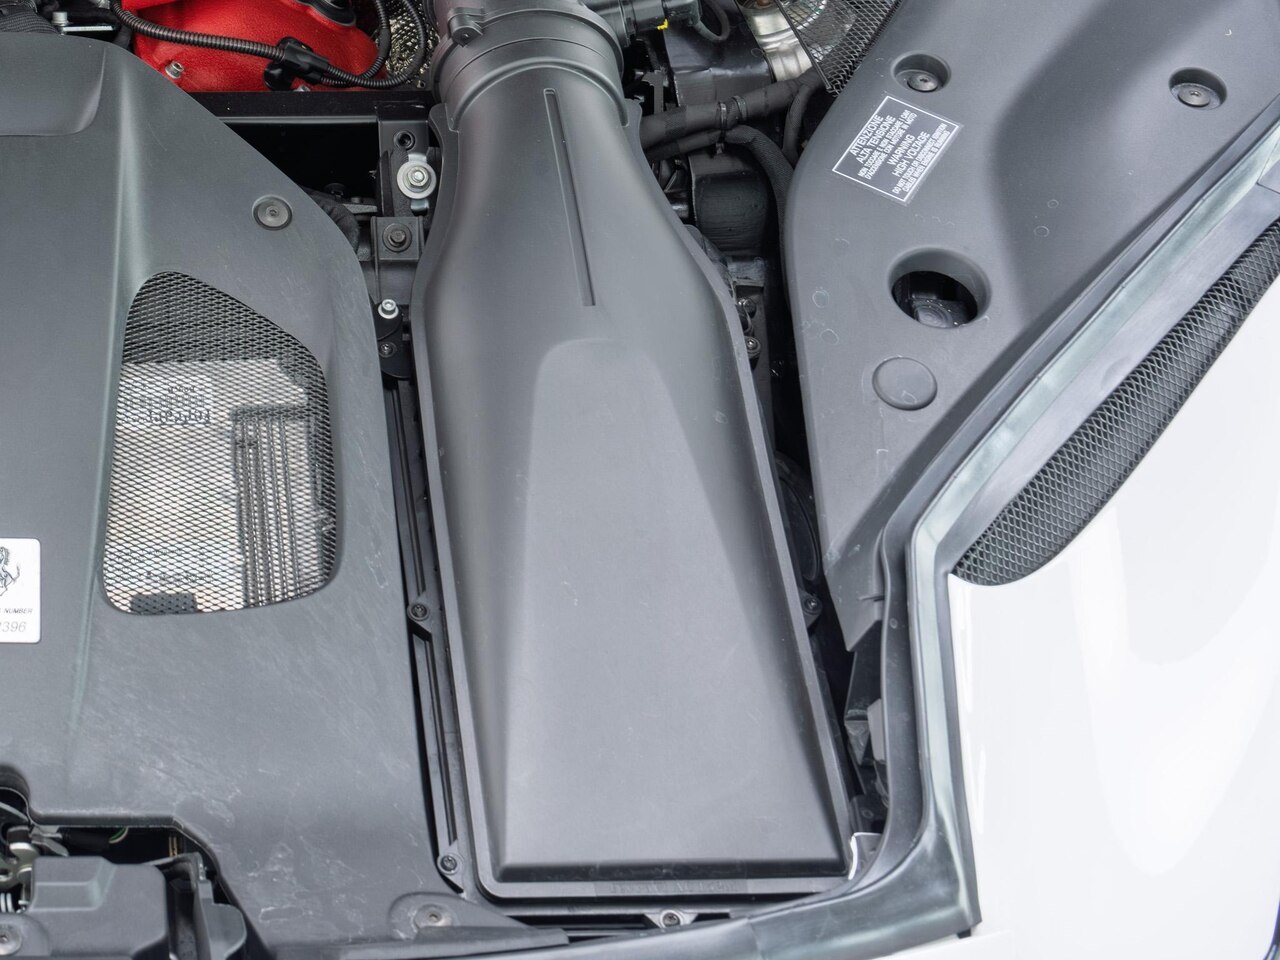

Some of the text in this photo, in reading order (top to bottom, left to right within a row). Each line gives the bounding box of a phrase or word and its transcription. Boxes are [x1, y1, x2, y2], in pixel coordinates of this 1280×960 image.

[848, 114, 884, 155] ATTENZIONE
[854, 114, 896, 163] ALTA TENSIONE
[886, 133, 916, 166] WARNING
[891, 130, 931, 177] HIGH VOLTAGE
